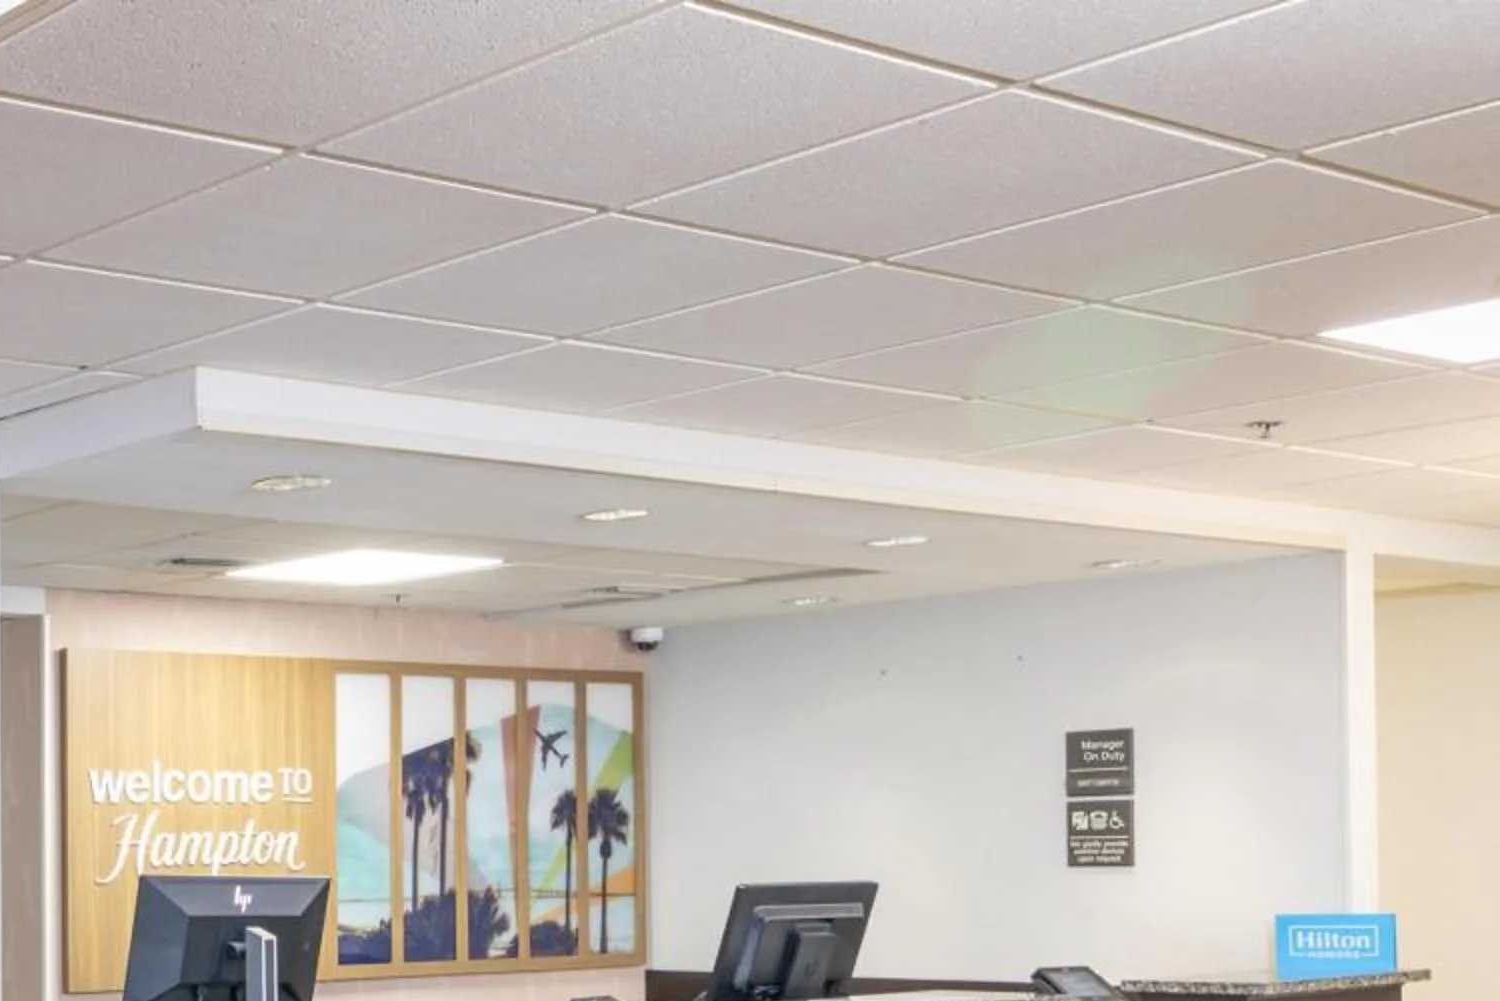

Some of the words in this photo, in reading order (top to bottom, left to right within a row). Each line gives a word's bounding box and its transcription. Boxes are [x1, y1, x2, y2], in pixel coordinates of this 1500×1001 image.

[1081, 740, 1125, 750] Manager
[1083, 751, 1099, 761] On
[1101, 751, 1125, 761] Duty
[88, 759, 274, 804] welcome
[278, 767, 313, 795] TO
[95, 809, 306, 885] Hampton
[234, 885, 253, 913] hp
[1297, 931, 1370, 949] Hilton
